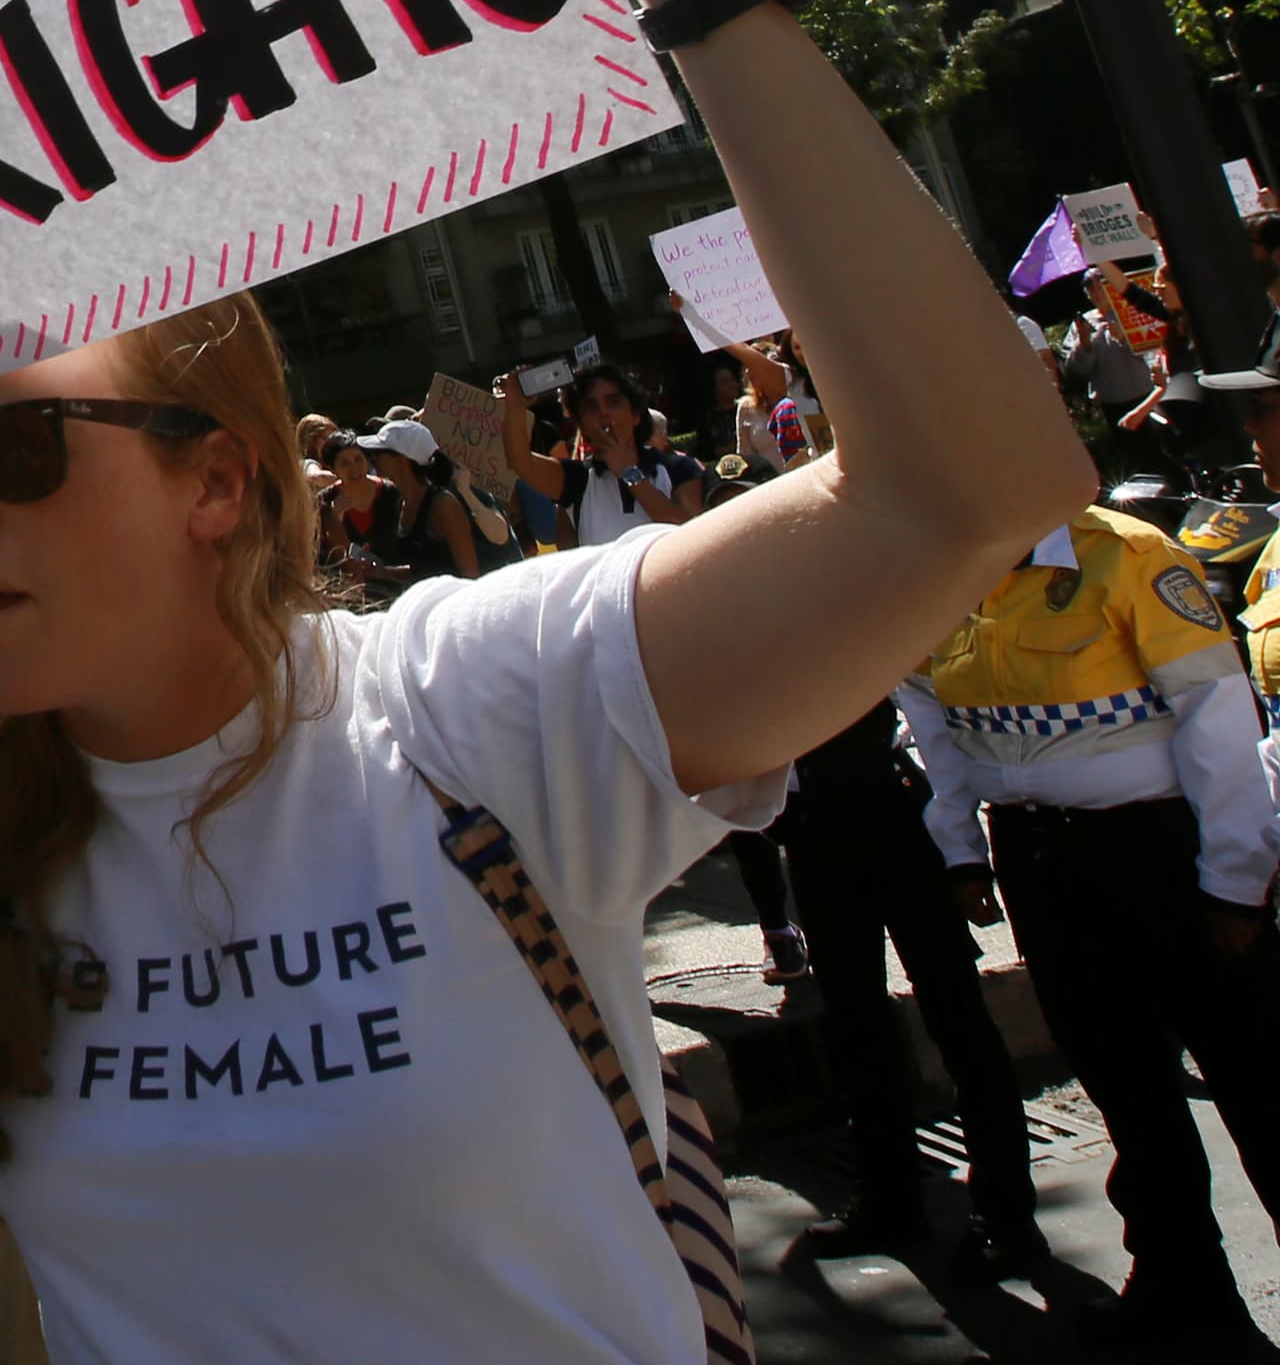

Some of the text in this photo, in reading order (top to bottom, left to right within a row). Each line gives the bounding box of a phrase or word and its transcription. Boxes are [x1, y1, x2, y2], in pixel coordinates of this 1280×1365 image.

[1080, 214, 1132, 236] BRIDGES
[661, 243, 693, 264] We
[698, 233, 727, 251] the
[442, 379, 497, 415] BUILD
[452, 420, 497, 451] NOT
[137, 901, 427, 1013] FUTURE
[78, 1006, 412, 1101] FEMALE
